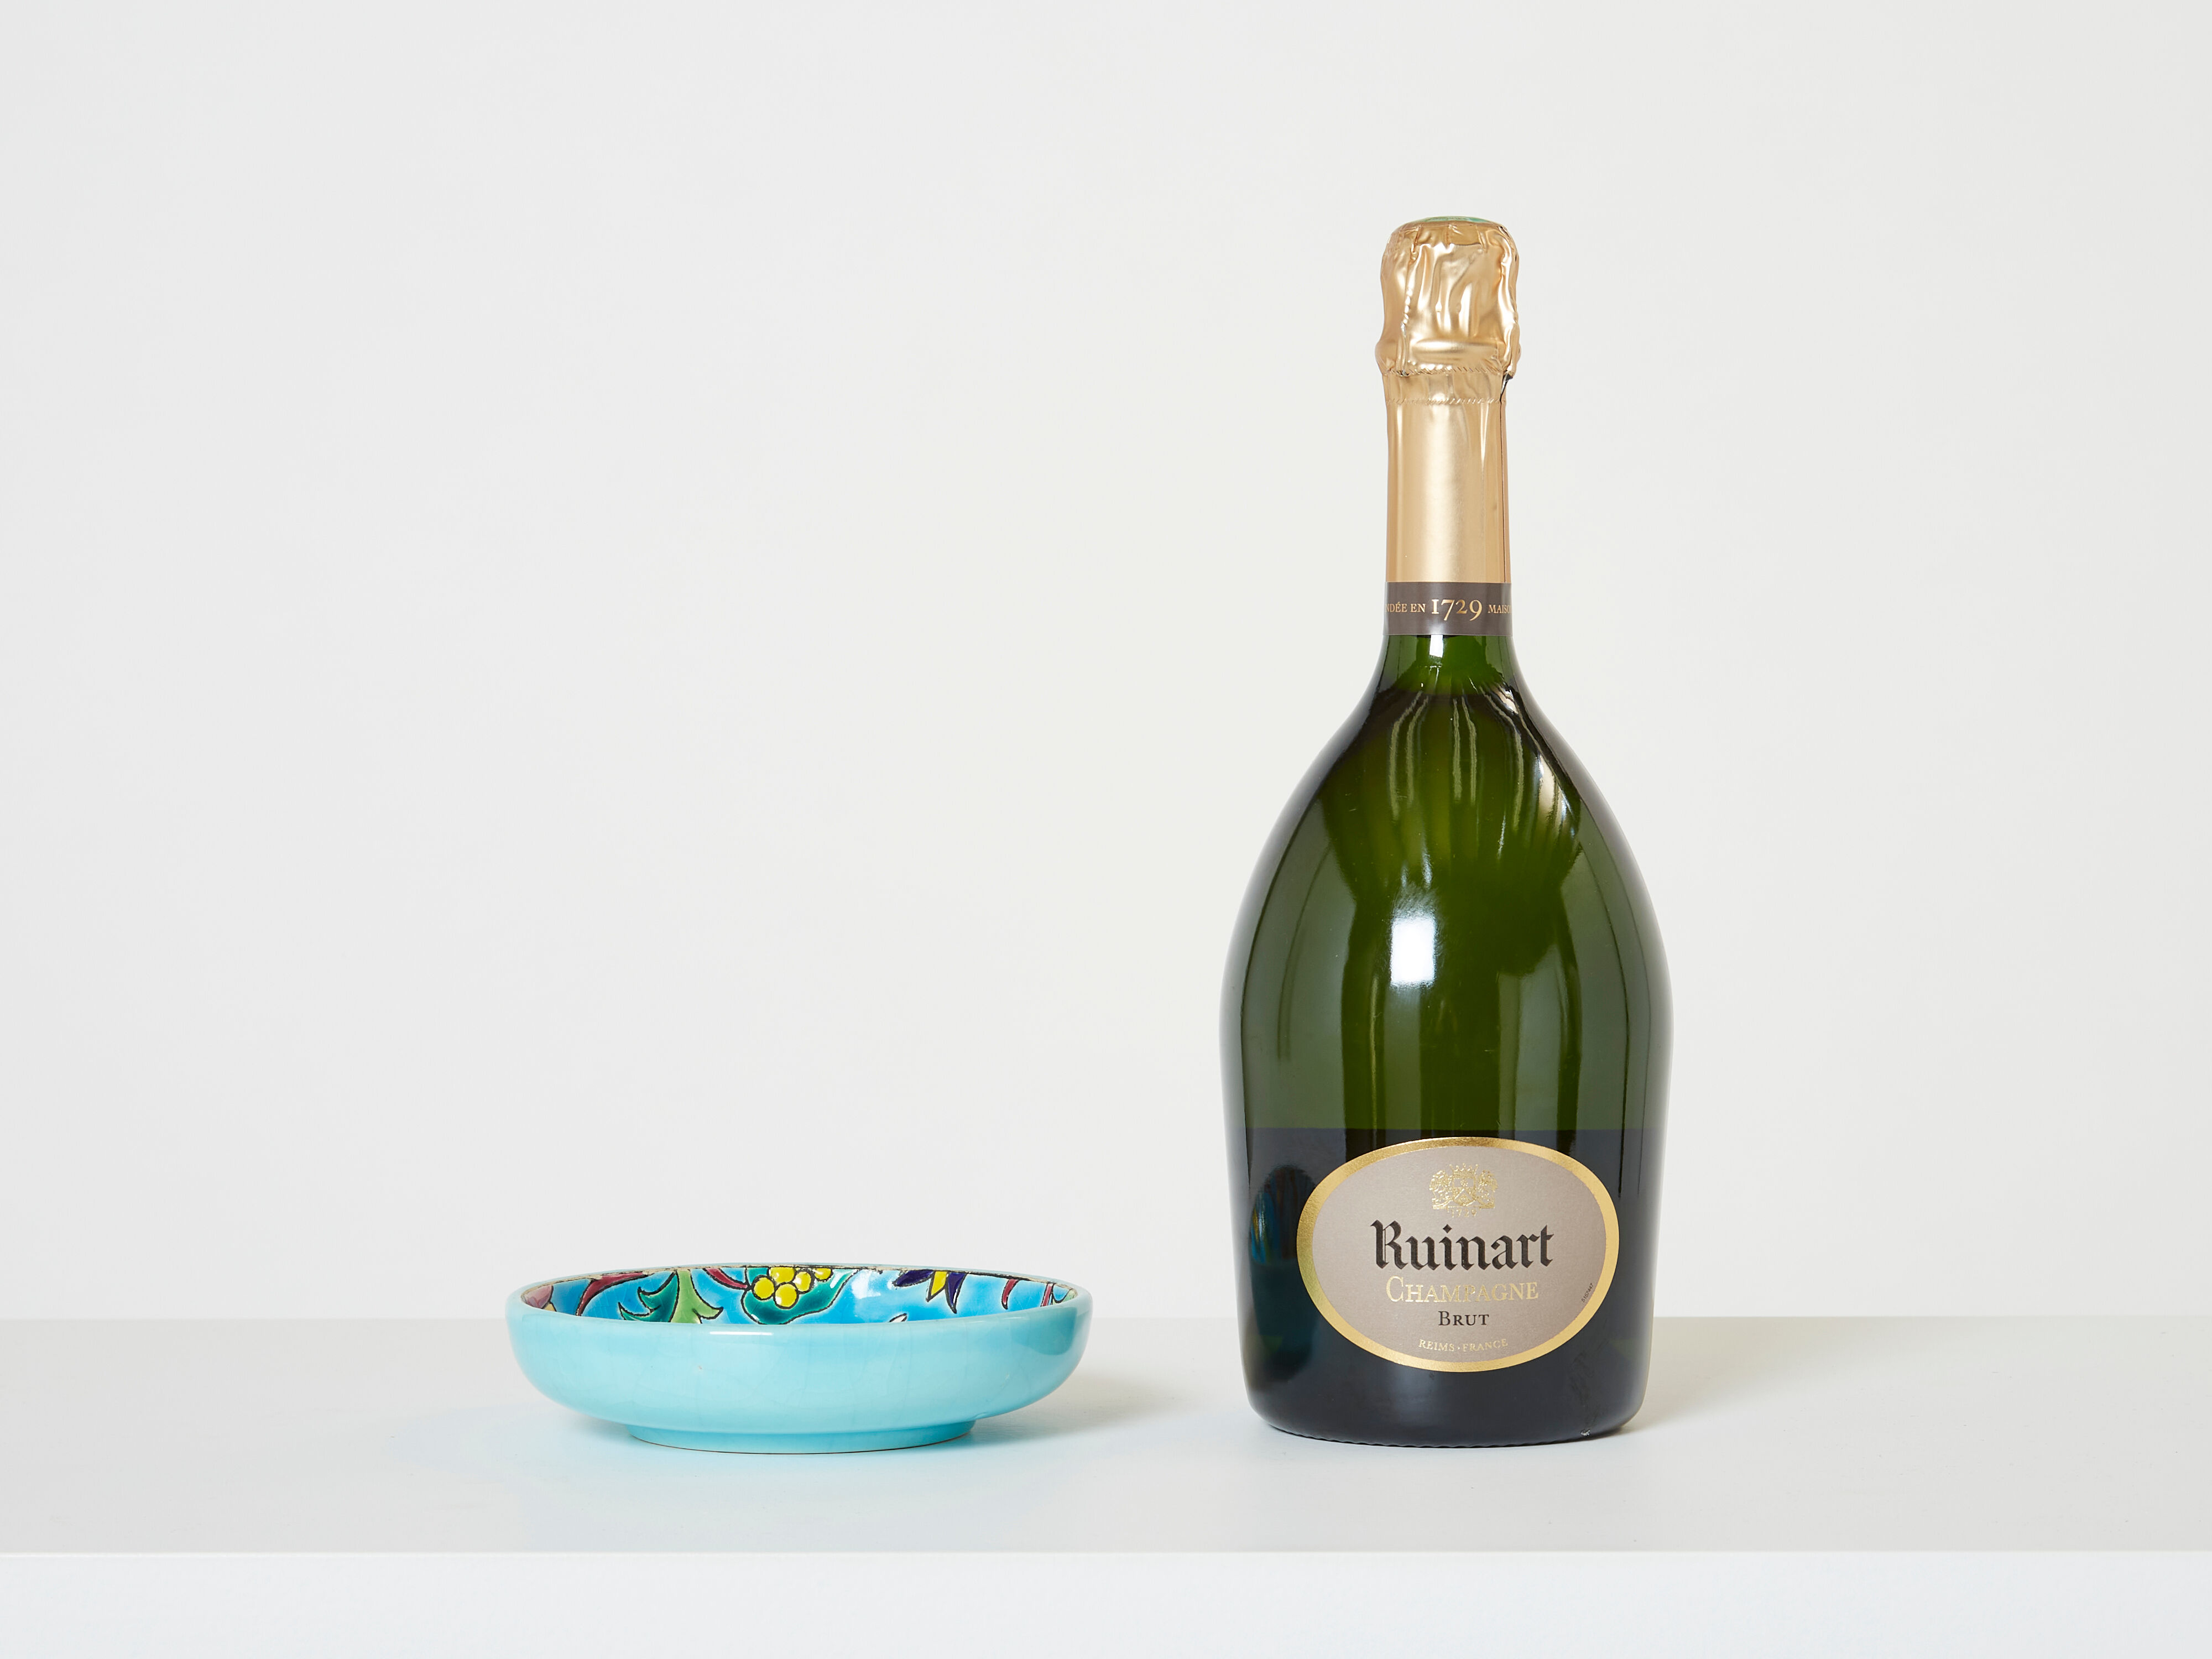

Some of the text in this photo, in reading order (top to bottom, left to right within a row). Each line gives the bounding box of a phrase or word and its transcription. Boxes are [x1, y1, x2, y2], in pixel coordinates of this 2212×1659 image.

[1411, 603, 1426, 613] EN
[1431, 599, 1483, 621] 1729
[1451, 1208, 1477, 1218] 1729
[1371, 1220, 1554, 1270] Ruinart
[1386, 1276, 1538, 1302] CHAMPAGNE
[1438, 1311, 1490, 1326] BRUT
[1418, 1338, 1509, 1352] REIMS FRANCE
